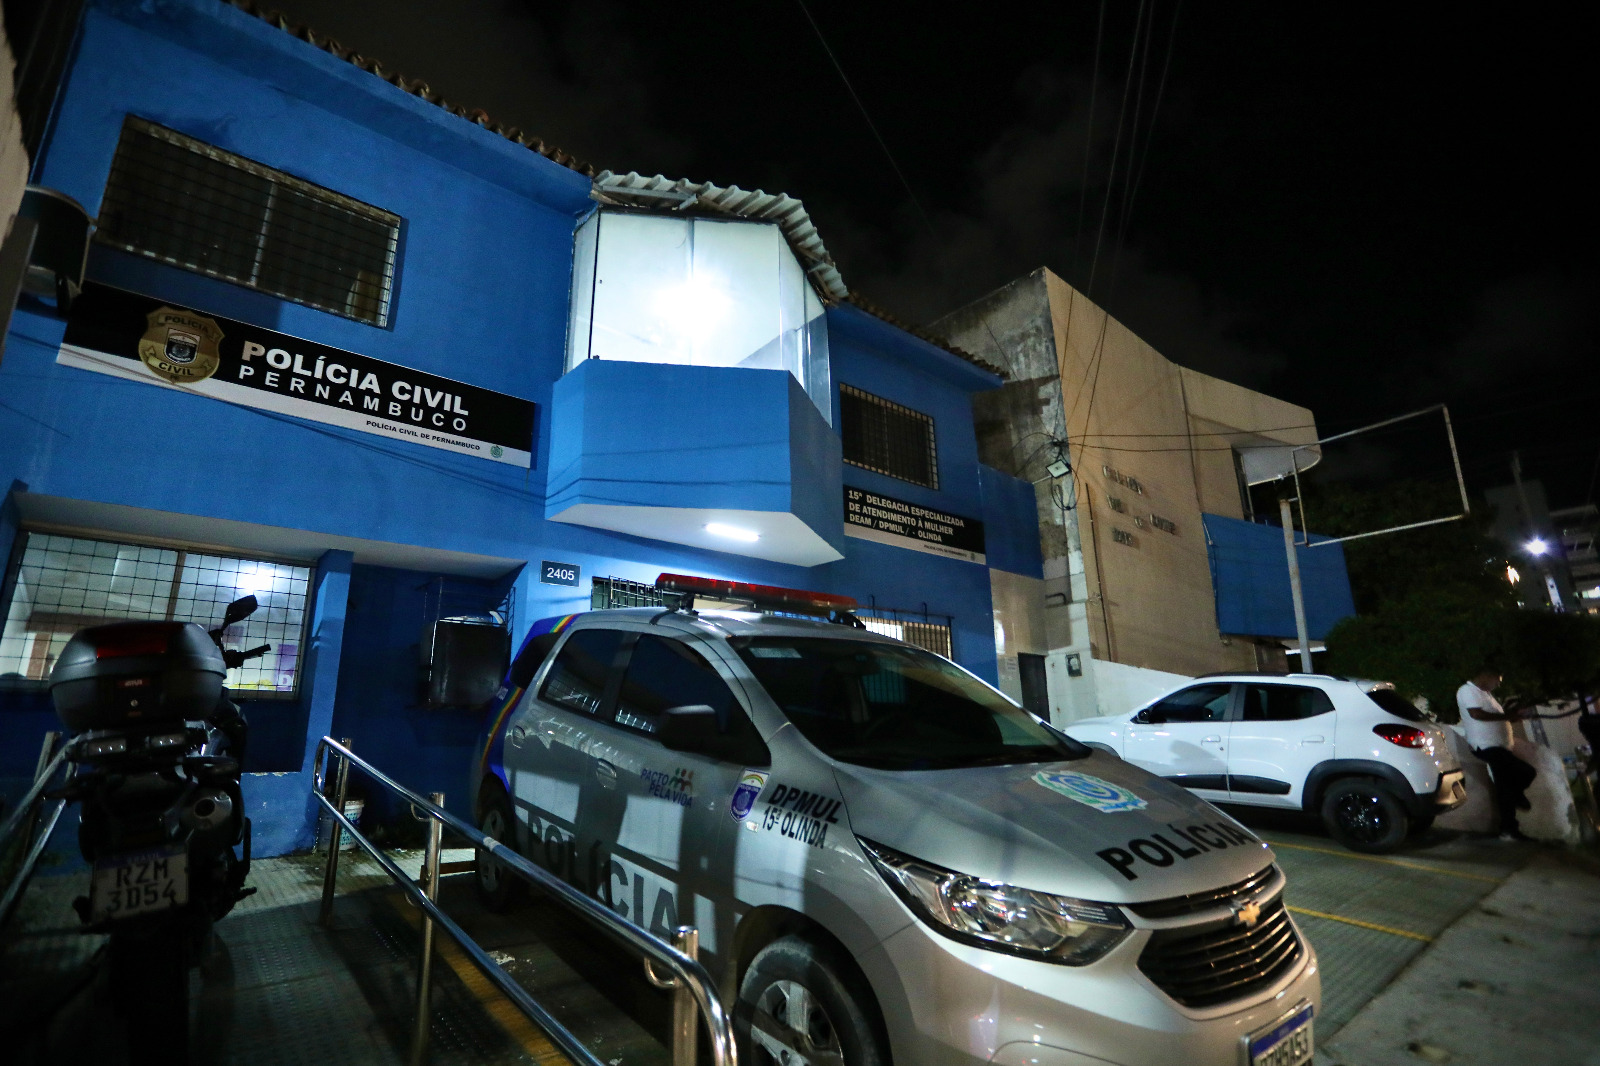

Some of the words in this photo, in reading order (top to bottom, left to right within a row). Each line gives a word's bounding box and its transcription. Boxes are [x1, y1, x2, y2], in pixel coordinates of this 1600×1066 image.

[158, 362, 194, 376] CIVIL
[241, 339, 382, 394] POLÍCIA
[391, 380, 470, 416] CIVIL
[238, 365, 468, 432] PERNAMBUCO
[366, 420, 397, 432] POLÍCIA
[399, 428, 418, 437] CIVIL
[420, 432, 430, 440] DE
[431, 435, 480, 450] PERNAMBUCO
[848, 501, 861, 513] DE
[862, 506, 917, 527] ATENDIMENTO
[924, 521, 954, 535] MULHER
[849, 513, 872, 526] DEAM
[873, 519, 878, 529] /
[879, 520, 904, 534] DPMUL
[917, 530, 943, 543] OLINDA
[866, 494, 909, 514] DELEGACIA
[911, 506, 965, 528] ESPECIALIZADA
[546, 567, 575, 581] 2405
[640, 768, 669, 786] PACTO
[649, 782, 670, 801] PELA
[672, 790, 693, 808] VIDA
[767, 784, 842, 824] DPMUL
[781, 811, 828, 850] OLINDA
[1095, 821, 1260, 882] POLÍCIA
[117, 858, 168, 887] RZM
[106, 879, 177, 913] 3D54
